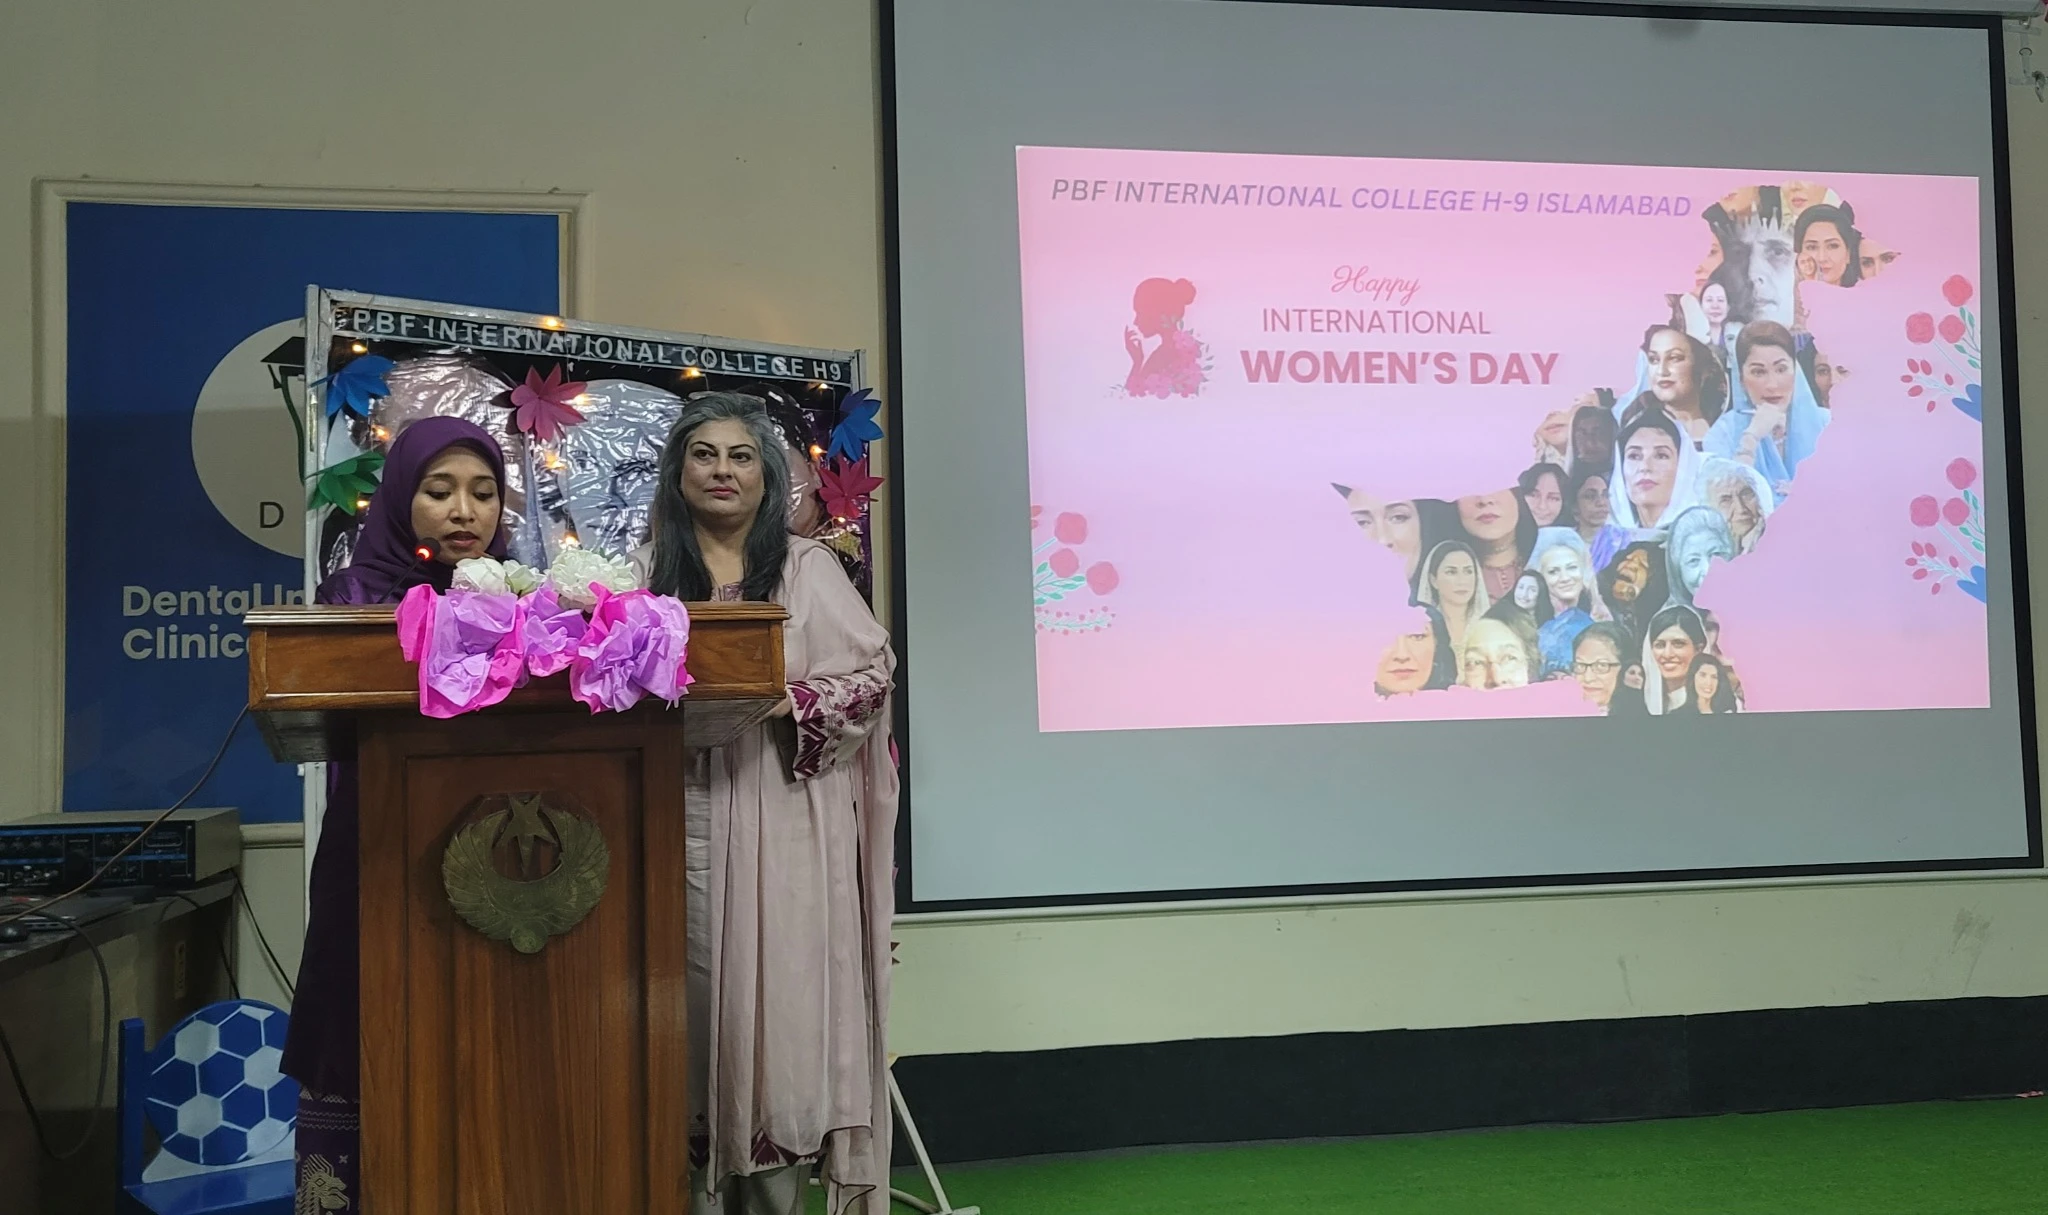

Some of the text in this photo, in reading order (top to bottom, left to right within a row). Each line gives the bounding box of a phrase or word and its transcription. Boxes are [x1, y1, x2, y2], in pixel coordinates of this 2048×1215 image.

[1052, 179, 1691, 217] PBF INTERNATIONAL COLLEGE H-9 ISLAMABAD
[1331, 264, 1420, 306] Happy
[1262, 308, 1491, 334] INTERNATIONAL
[353, 309, 842, 381] PBF INTERNATIONAL COLLEGE H9
[1240, 350, 1559, 385] WOMEN’S DAY
[122, 583, 262, 617] Dental
[122, 624, 250, 660] Clinic
